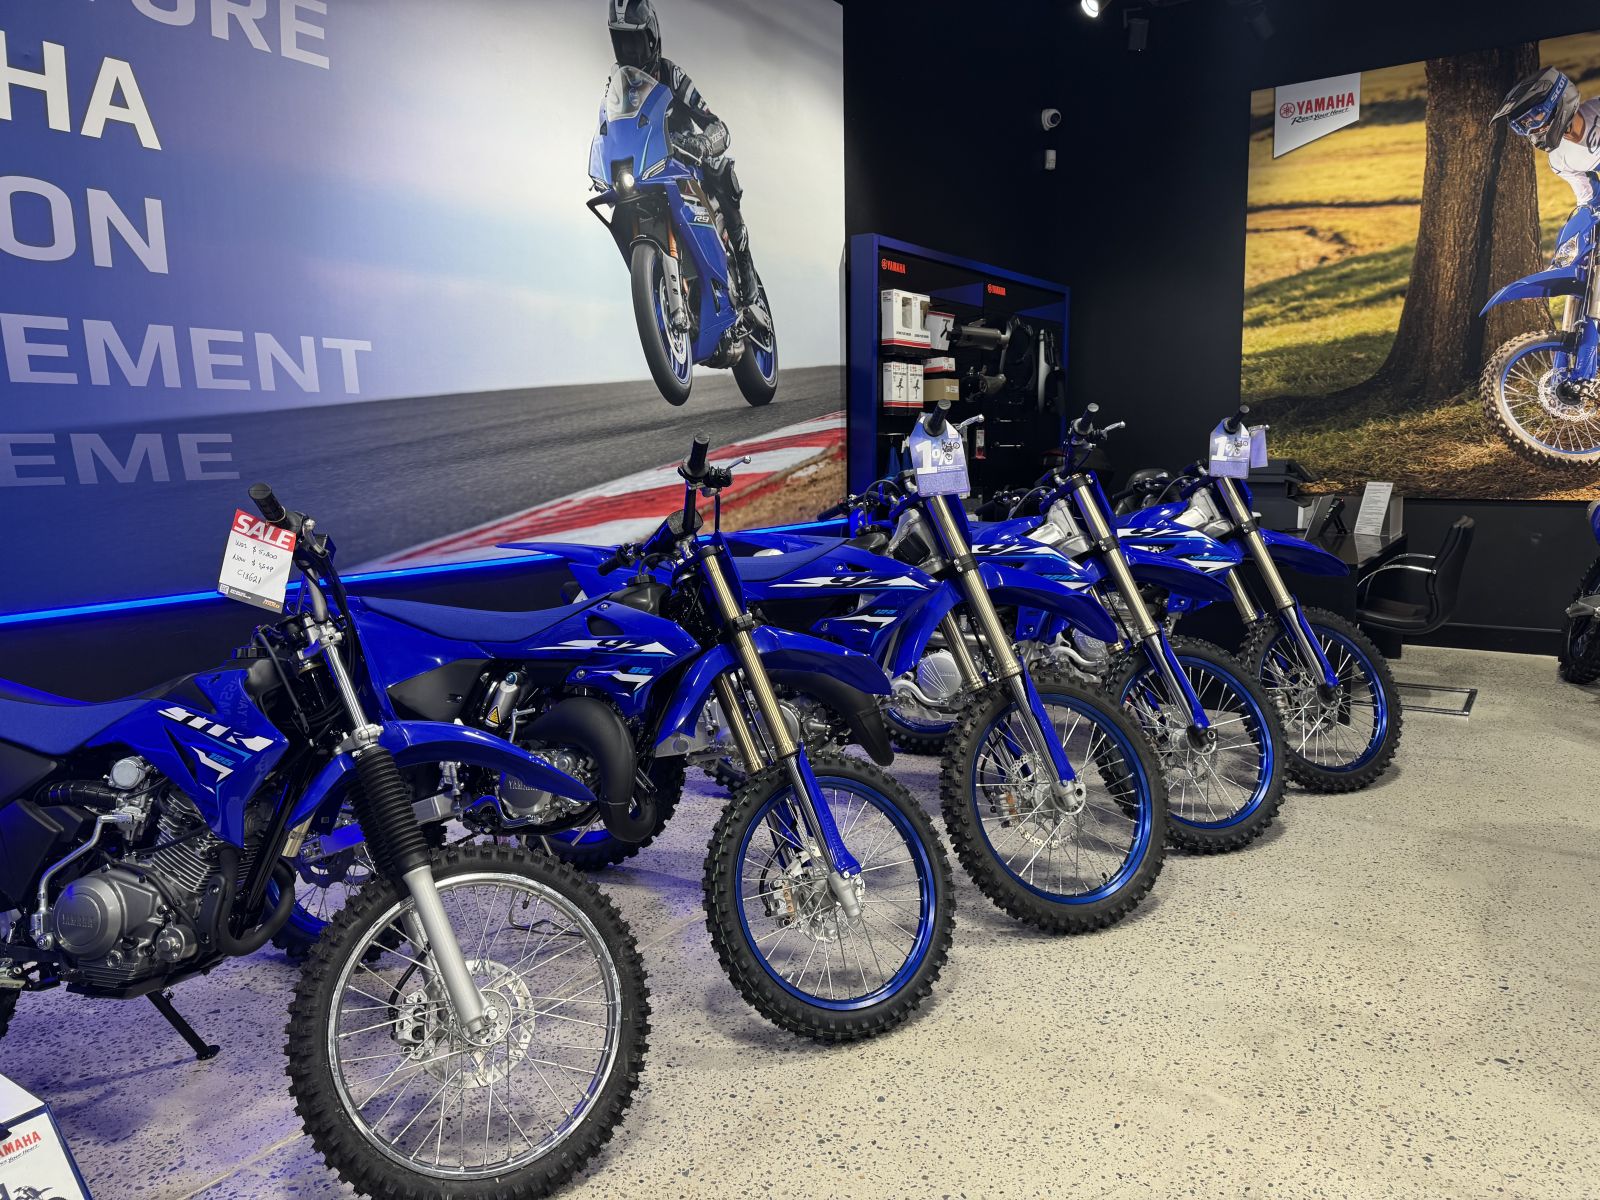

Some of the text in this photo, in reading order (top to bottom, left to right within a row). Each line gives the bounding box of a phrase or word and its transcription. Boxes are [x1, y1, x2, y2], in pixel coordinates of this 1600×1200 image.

[1297, 92, 1355, 115] YAMAHA
[0, 175, 168, 274] ON
[0, 313, 372, 394] EMENT
[0, 433, 240, 487] EME
[234, 514, 294, 549] SALE
[627, 666, 654, 675] 85
